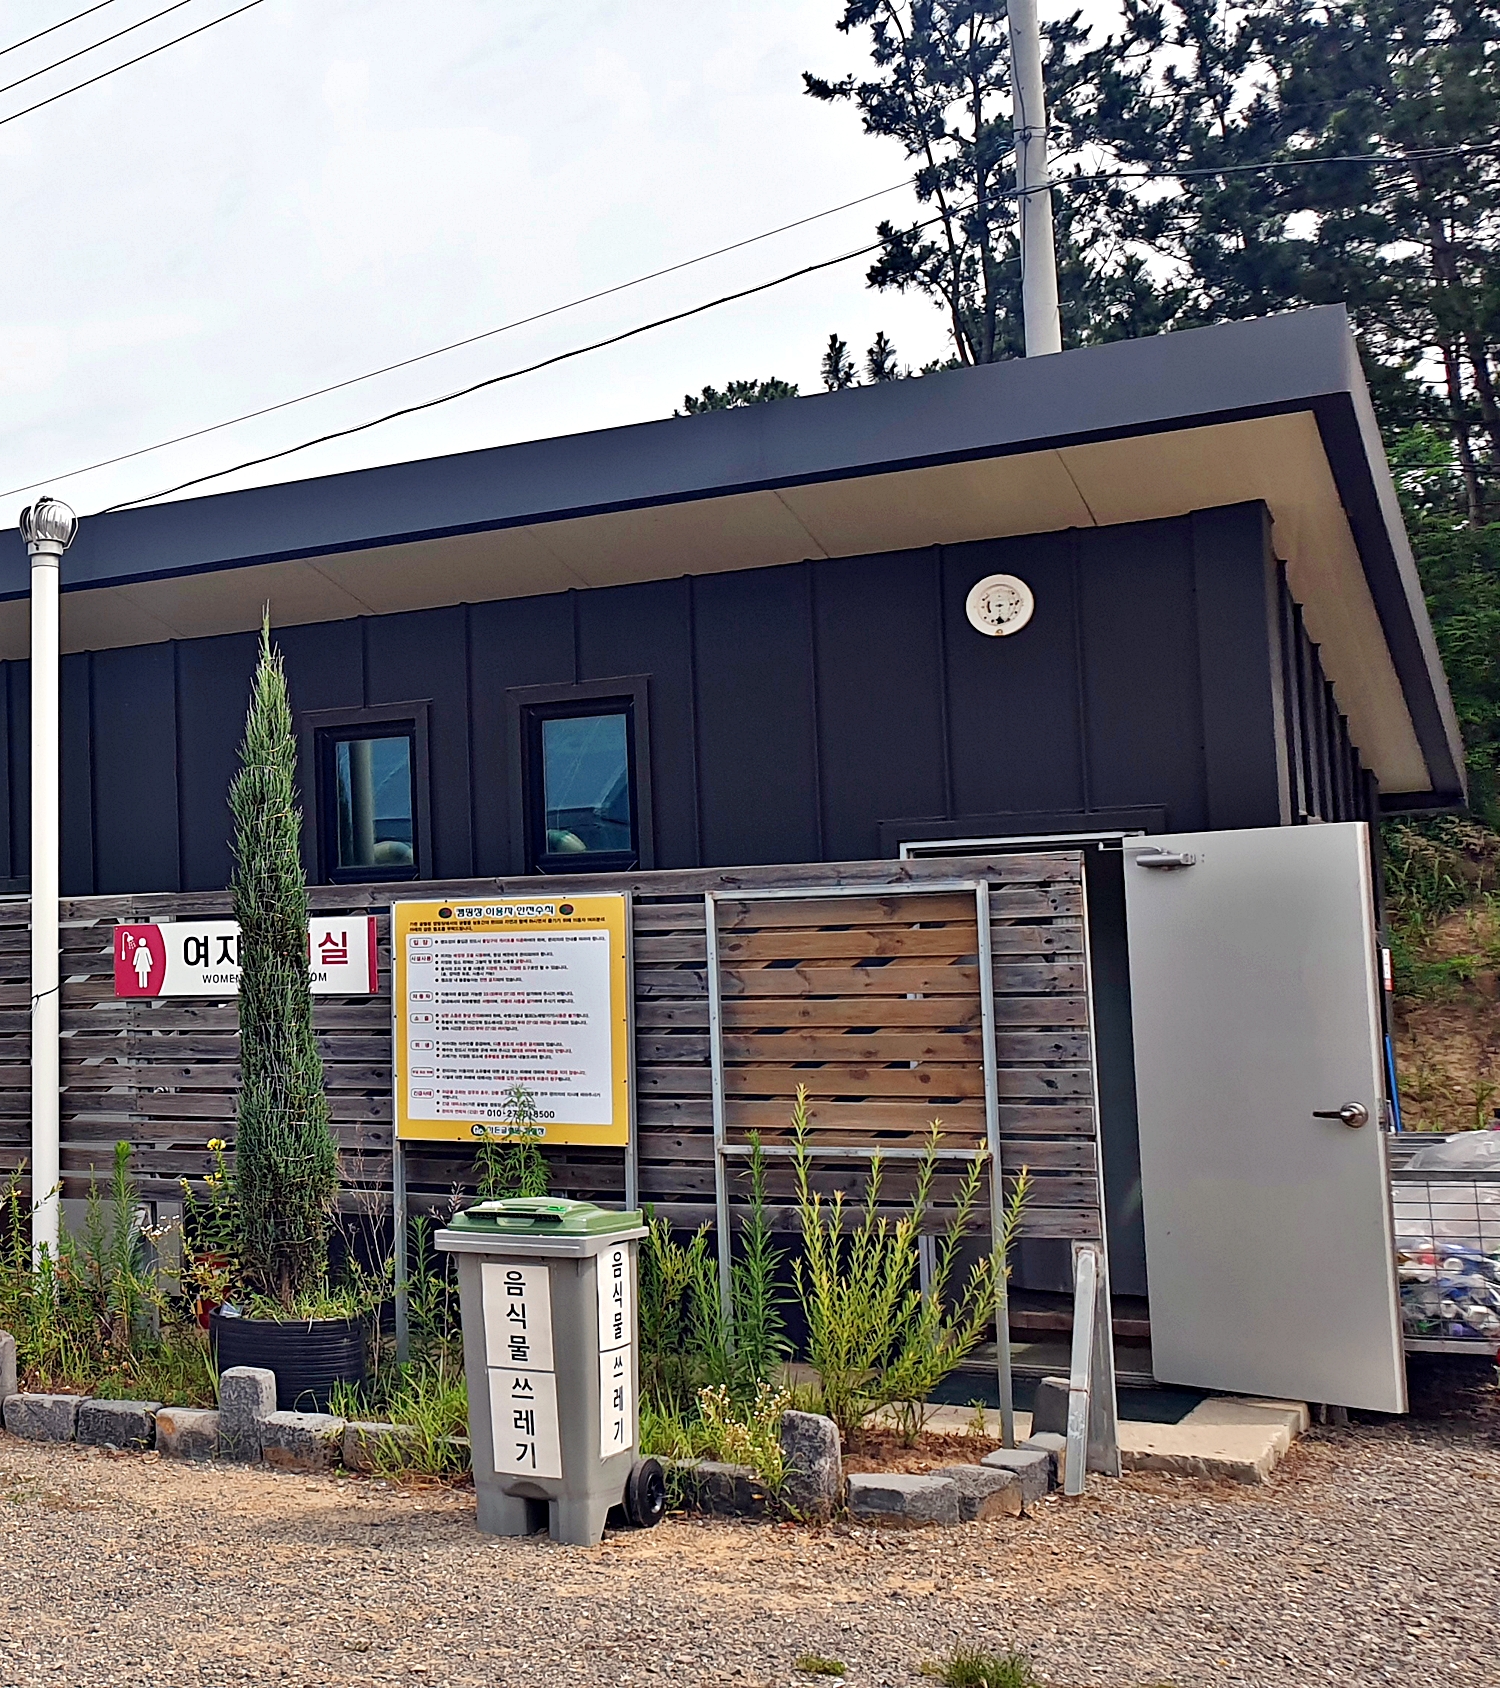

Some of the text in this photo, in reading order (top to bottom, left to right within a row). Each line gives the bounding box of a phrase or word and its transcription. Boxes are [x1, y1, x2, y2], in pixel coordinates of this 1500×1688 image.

[183, 931, 349, 969] 여자실
[485, 906, 514, 917] 이용자
[503, 1270, 537, 1469] 음식물 쓰레기
[611, 1251, 624, 1445] 음식물 쓰레기
